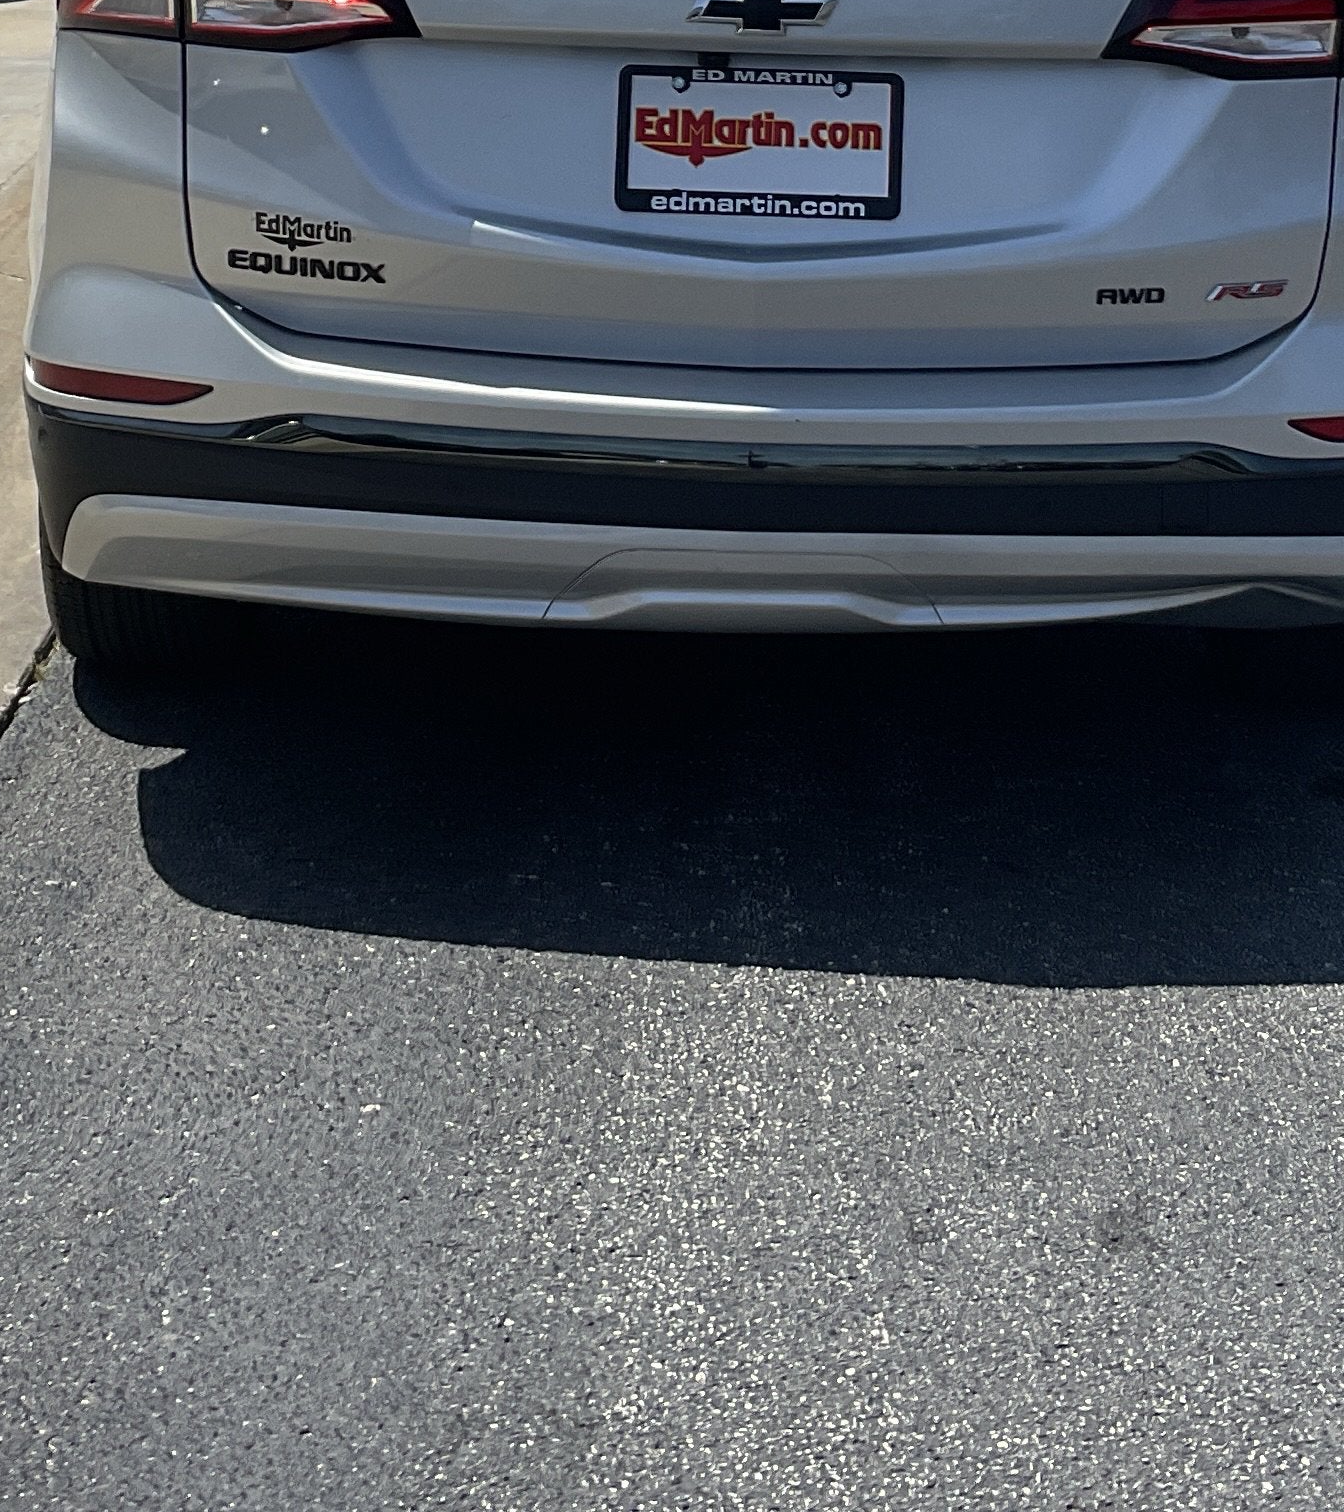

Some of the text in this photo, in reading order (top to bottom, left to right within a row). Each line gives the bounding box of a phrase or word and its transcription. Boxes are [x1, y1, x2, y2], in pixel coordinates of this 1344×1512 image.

[692, 69, 834, 85] ED MARTIN
[634, 107, 883, 152] EdMartin.com
[650, 192, 866, 217] edmartin.com
[255, 211, 352, 244] EdMartin
[227, 249, 386, 284] EQUINOX
[1096, 279, 1289, 305] AWD RS
